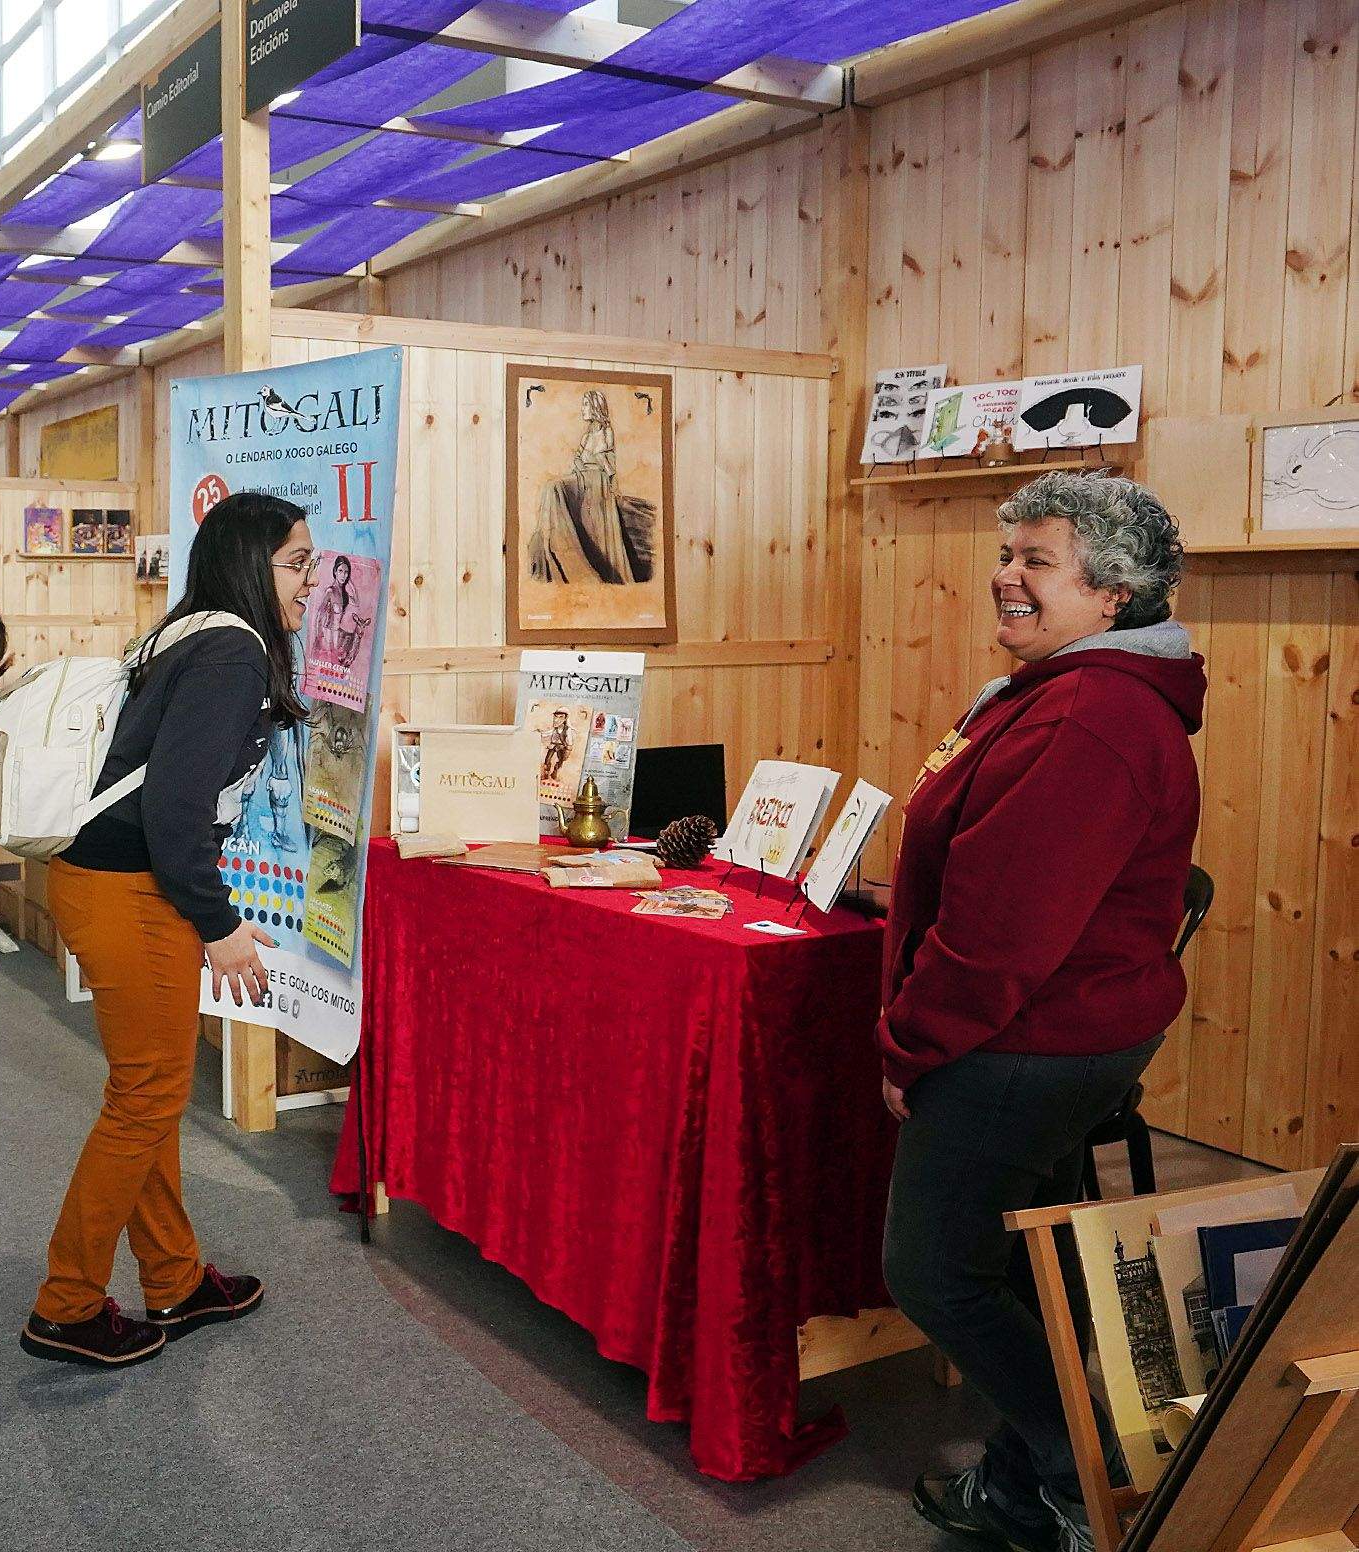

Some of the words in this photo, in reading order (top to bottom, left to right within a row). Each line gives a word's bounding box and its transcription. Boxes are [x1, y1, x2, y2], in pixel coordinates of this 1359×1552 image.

[250, 0, 298, 39] Dornavela
[250, 28, 289, 66] Edicións
[147, 91, 168, 119] Cumio
[168, 62, 199, 101] Editorial
[225, 453, 234, 465] O
[235, 448, 283, 464] LENDARIO
[285, 445, 315, 460] XOGO
[316, 441, 359, 456] GALEGO
[197, 479, 222, 514] 25
[290, 481, 318, 498] Galega
[331, 460, 379, 523] II
[279, 972, 286, 985] E
[288, 975, 309, 995] GOZA
[311, 985, 329, 1004] COS
[331, 993, 356, 1015] MITOS
